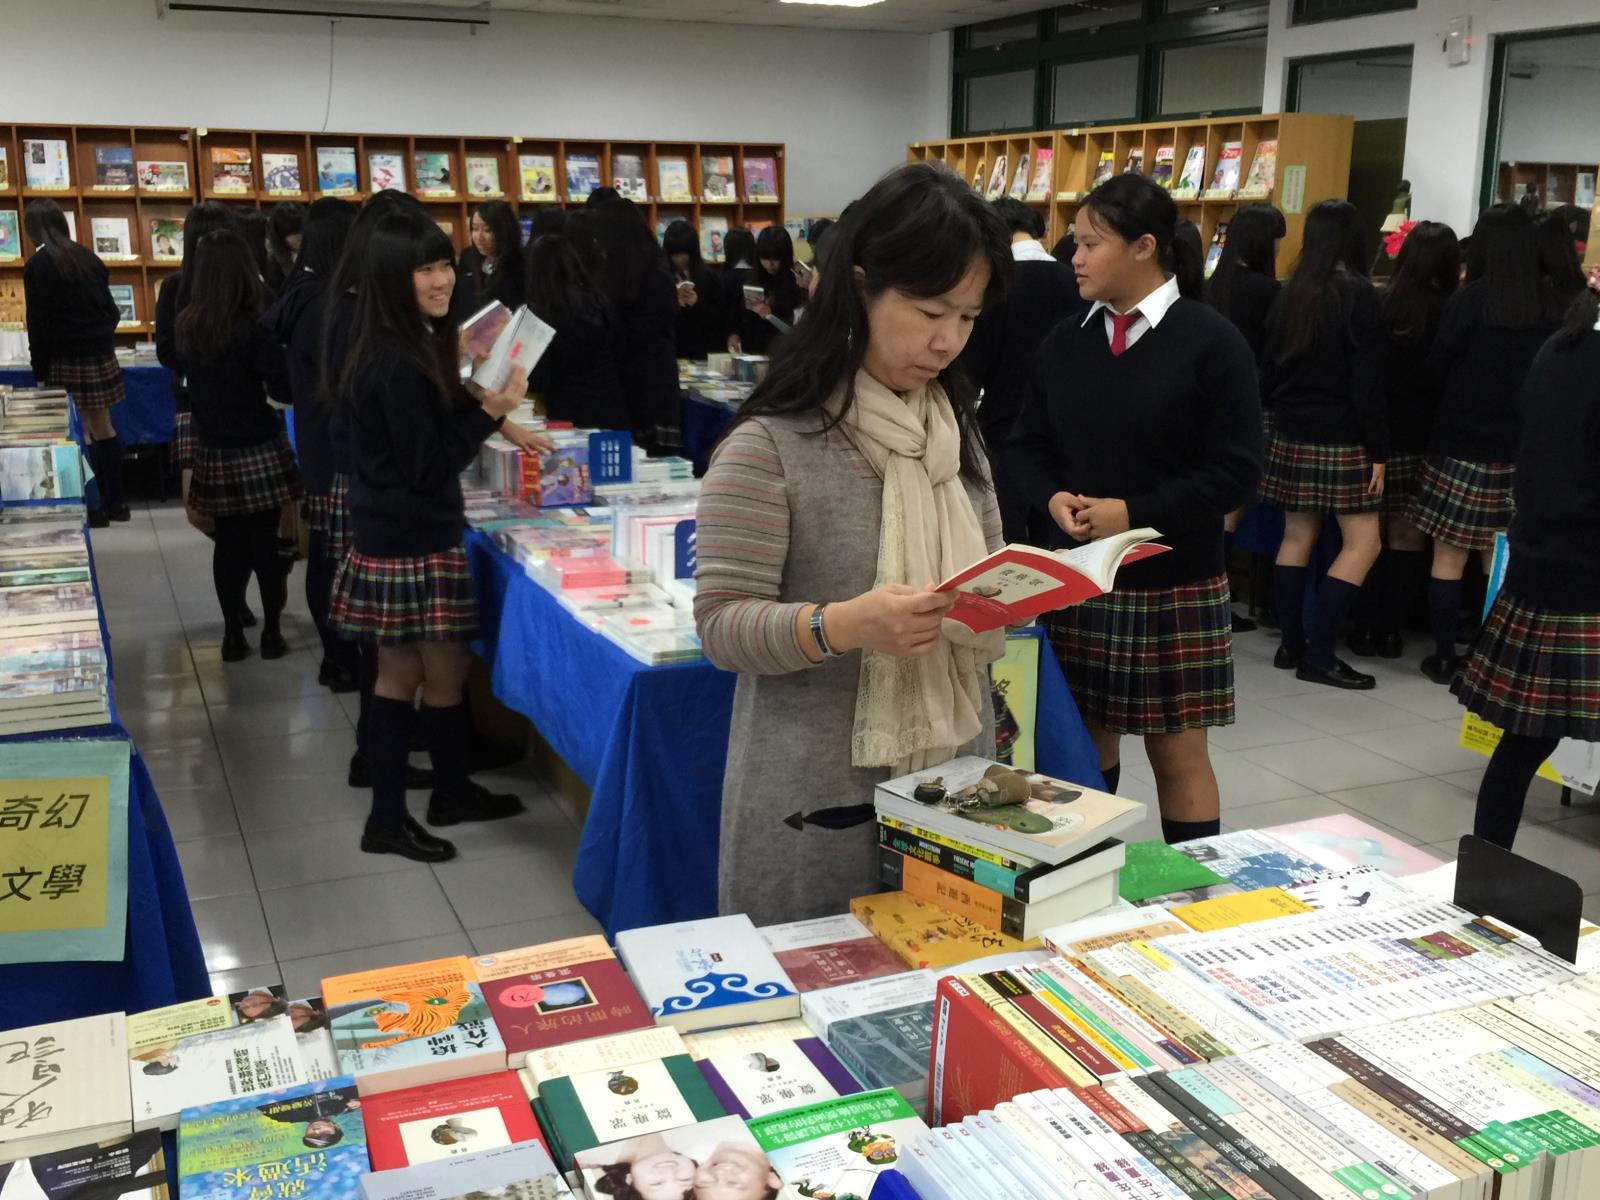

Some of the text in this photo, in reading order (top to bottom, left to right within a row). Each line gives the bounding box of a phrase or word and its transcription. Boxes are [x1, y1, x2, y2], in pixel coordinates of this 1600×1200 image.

[0, 793, 90, 831] 奇幻
[0, 864, 87, 902] 文學
[511, 1004, 632, 1035] 時間的旅人
[1213, 1140, 1261, 1172] 創作課
[1231, 1137, 1279, 1168] 創作課
[223, 1152, 327, 1189] 活過來
[249, 1178, 306, 1200] 就會
